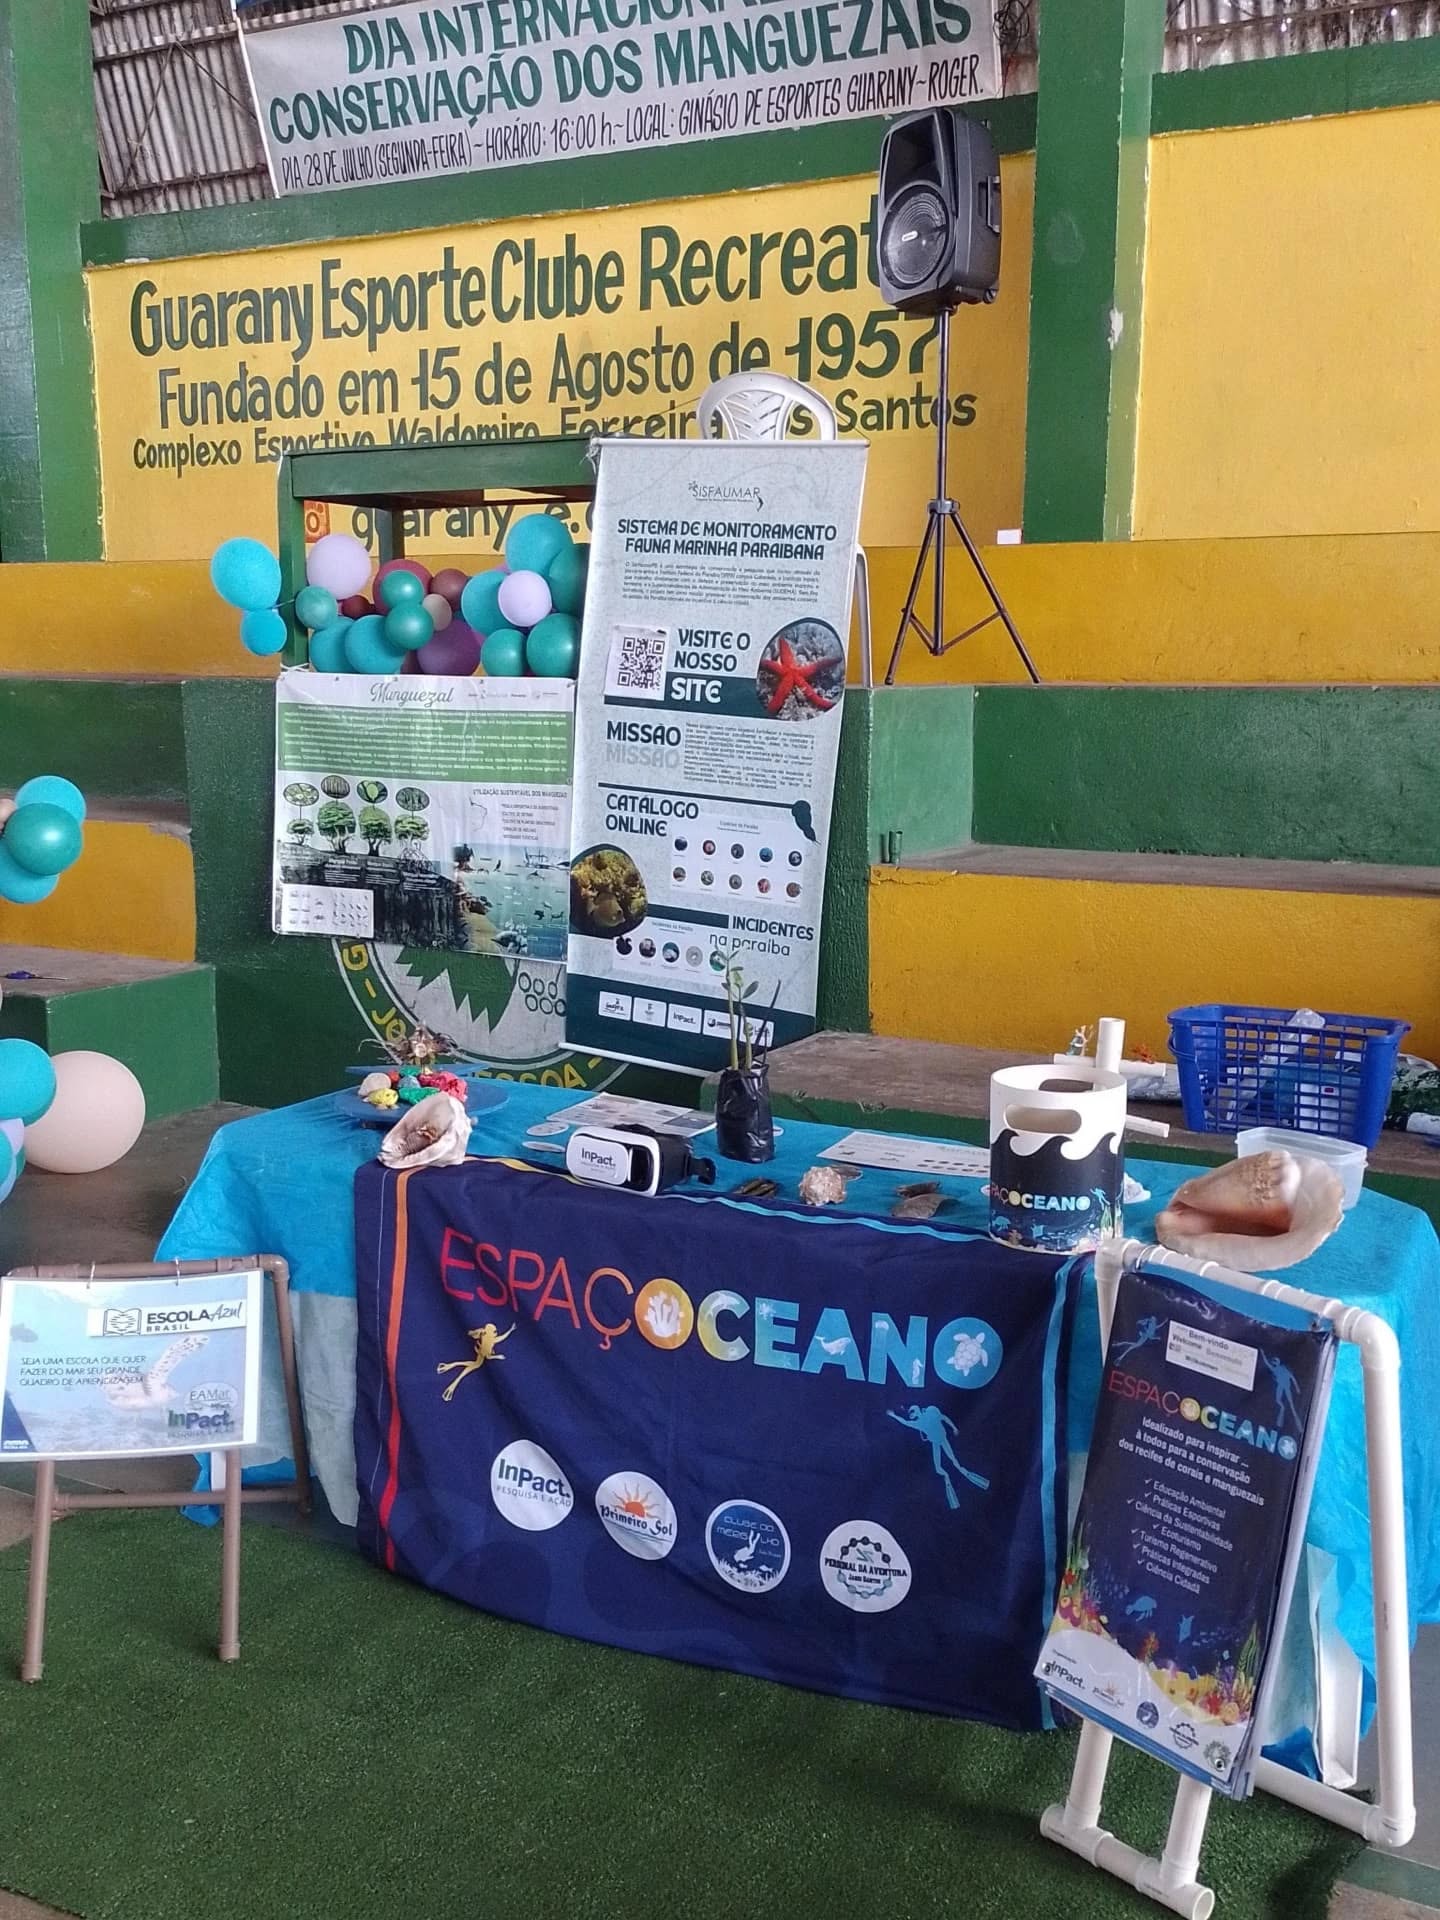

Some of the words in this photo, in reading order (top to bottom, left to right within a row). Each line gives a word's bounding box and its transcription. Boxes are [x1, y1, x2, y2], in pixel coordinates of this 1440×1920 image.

[343, 17, 415, 74] DIA
[419, 0, 785, 62] INTERNACI
[269, 54, 543, 144] CONSERVAÇÃO
[553, 39, 643, 102] DOS
[655, 0, 972, 88] MANGUEZAIS
[282, 157, 303, 190] DIA
[304, 154, 323, 187] 28
[324, 151, 341, 184] DE
[341, 144, 373, 184] JULHO
[550, 114, 597, 153] 16:00
[678, 88, 738, 136] GINÁSIO
[744, 87, 763, 128] DE
[766, 78, 841, 124] ESPORTES
[130, 279, 313, 362] Guarany
[321, 246, 486, 352] Esporte
[491, 233, 625, 324] Clube
[639, 194, 880, 311] Recreat
[159, 361, 324, 429] Fundado
[338, 366, 399, 416] em
[411, 346, 461, 411] 15
[474, 342, 532, 406] de
[548, 326, 694, 407] Agosto
[710, 321, 770, 382] de
[785, 311, 940, 383] 1957
[133, 433, 243, 478] Complexo
[835, 382, 977, 433] Santos
[352, 505, 515, 551] garany
[617, 519, 677, 536] SISTEMA
[681, 521, 700, 536] DE
[703, 522, 837, 541] MONITORAMENTO
[625, 537, 670, 553] FAUNA
[674, 539, 737, 557] MARINHA
[740, 541, 824, 560] PARAIBANA
[678, 628, 733, 649] VISITE
[736, 633, 751, 650] O
[674, 651, 737, 672] NOSSO
[370, 683, 454, 707] Manguezal
[671, 677, 723, 703] SITE
[607, 721, 681, 746] MISSÃO
[605, 814, 667, 837] ONLINE
[710, 934, 727, 946] na
[732, 916, 814, 941] INCIDENTES
[581, 1147, 616, 1167] InPact.
[147, 1309, 210, 1325] ESCOLA
[210, 1301, 243, 1321] Azul
[146, 1324, 190, 1332] BRASIL
[20, 1367, 46, 1376] FAZER
[49, 1367, 64, 1375] DO
[66, 1367, 85, 1375] MAR
[105, 1366, 140, 1374] GRANDE
[42, 1357, 64, 1365] UMA
[66, 1356, 99, 1365] ESCOLA
[100, 1356, 121, 1364] QUE
[122, 1355, 147, 1363] QUER
[19, 1378, 59, 1386] QUADRO
[61, 1378, 73, 1386] DE
[1142, 1416, 1184, 1441] Idealizado
[1186, 1435, 1205, 1450] para
[1207, 1441, 1240, 1464] inspirar
[1143, 1434, 1167, 1449] todos
[1168, 1443, 1187, 1458] para
[1196, 1455, 1250, 1484] conservação
[498, 1458, 571, 1499] InPact.
[1119, 1438, 1134, 1452] dos
[1136, 1445, 1163, 1464] recifes
[1165, 1456, 1176, 1469] de
[1177, 1463, 1203, 1482] corais
[1205, 1475, 1211, 1483] e
[1212, 1476, 1265, 1506] manguezais
[496, 1484, 539, 1501] PESQUISA
[1153, 1481, 1189, 1502] Educação
[1190, 1495, 1226, 1519] Ambiental
[600, 1504, 648, 1530] Primeiro
[650, 1519, 673, 1536] Sol
[1153, 1494, 1181, 1514] Práticas
[1183, 1508, 1221, 1530] Esportivas
[1163, 1513, 1172, 1523] da
[1140, 1530, 1169, 1550] Turismo
[1161, 1526, 1201, 1550] Ecoturismo
